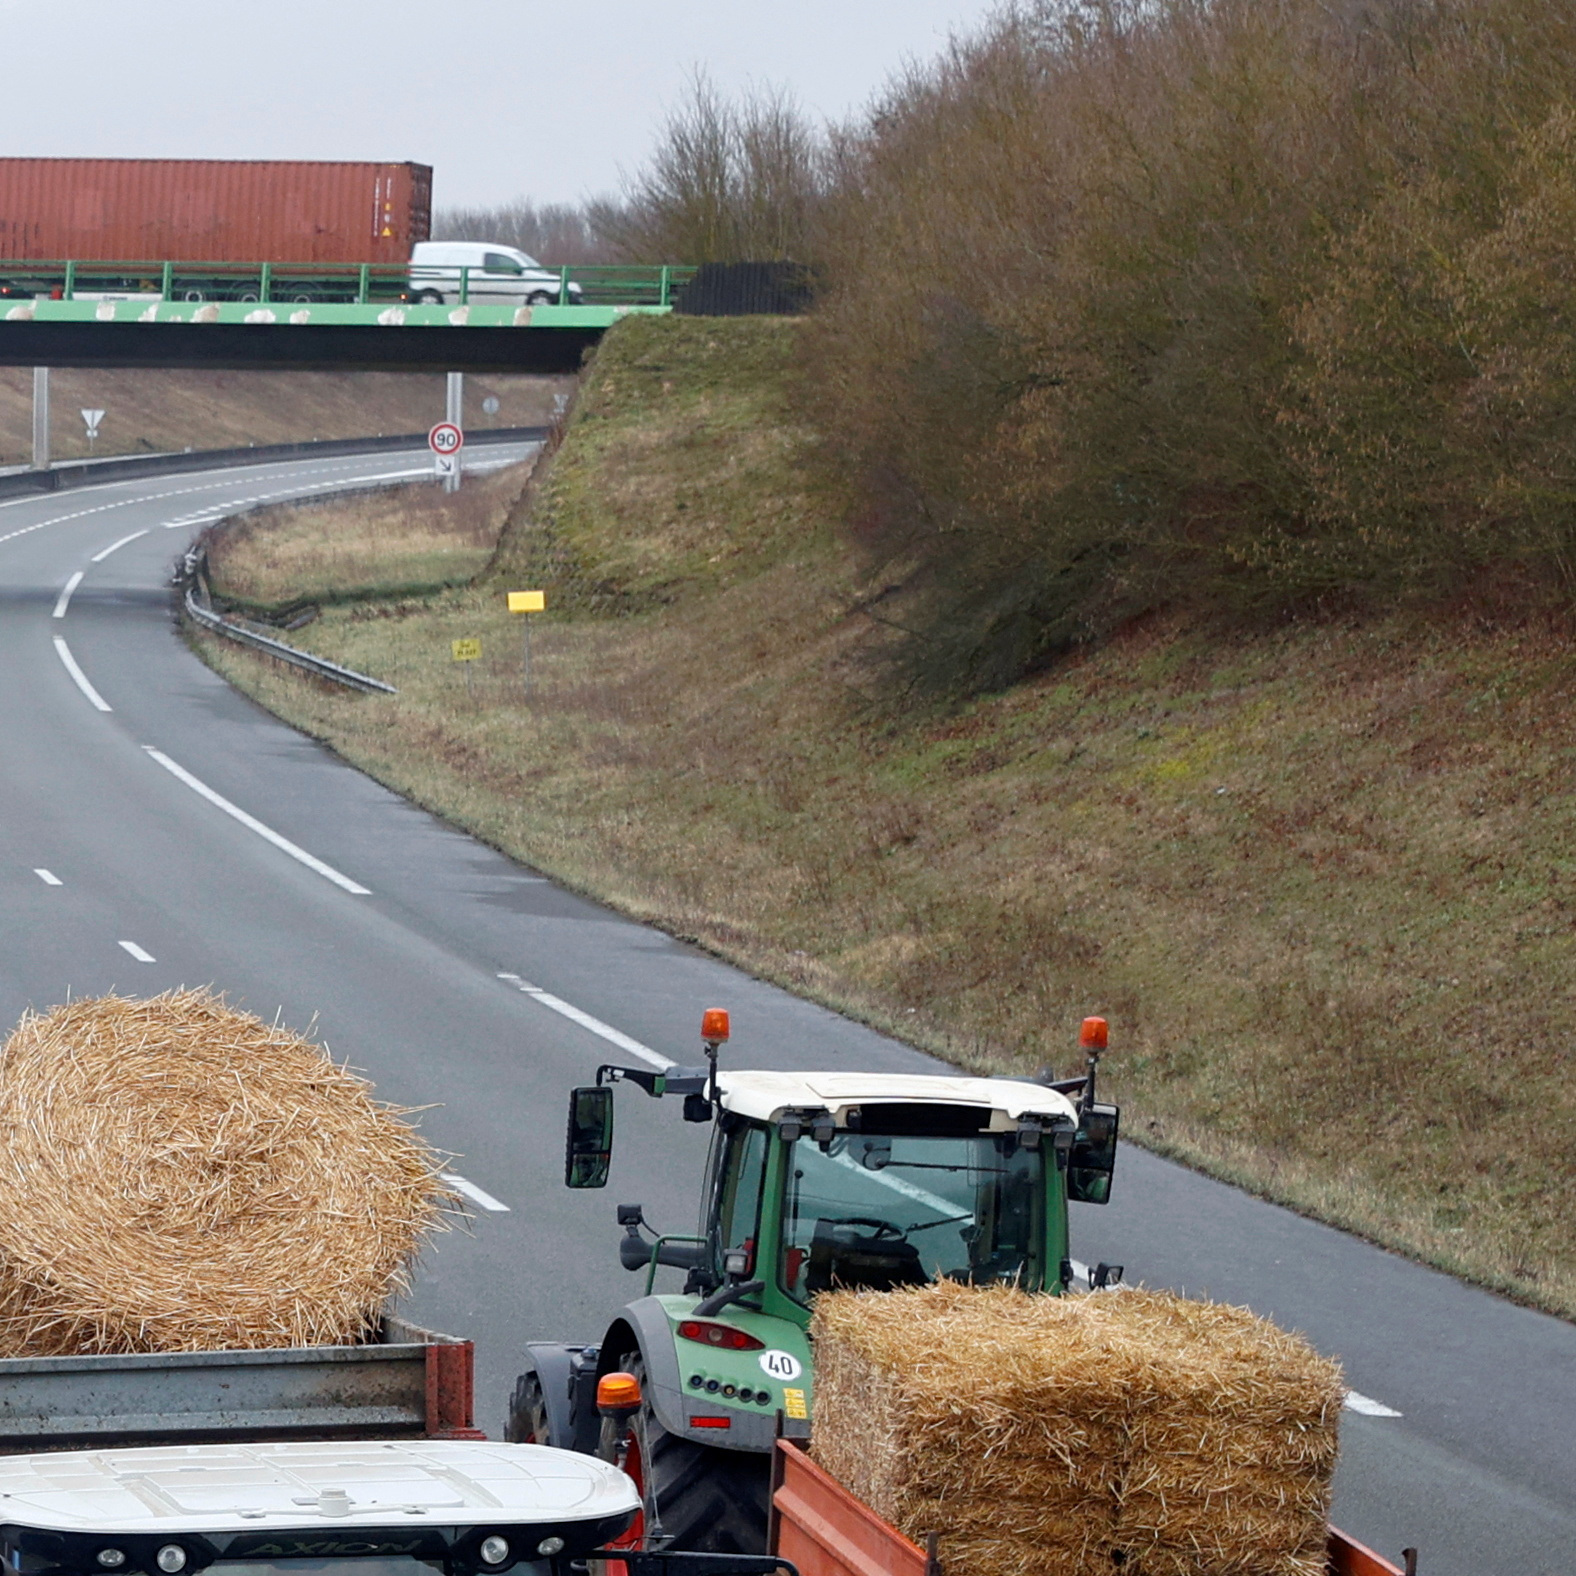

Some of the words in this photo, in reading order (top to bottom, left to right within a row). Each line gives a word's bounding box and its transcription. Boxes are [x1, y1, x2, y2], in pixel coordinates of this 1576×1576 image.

[437, 433, 455, 447] 90
[768, 1354, 794, 1376] 40
[243, 1539, 423, 1556] AXION
